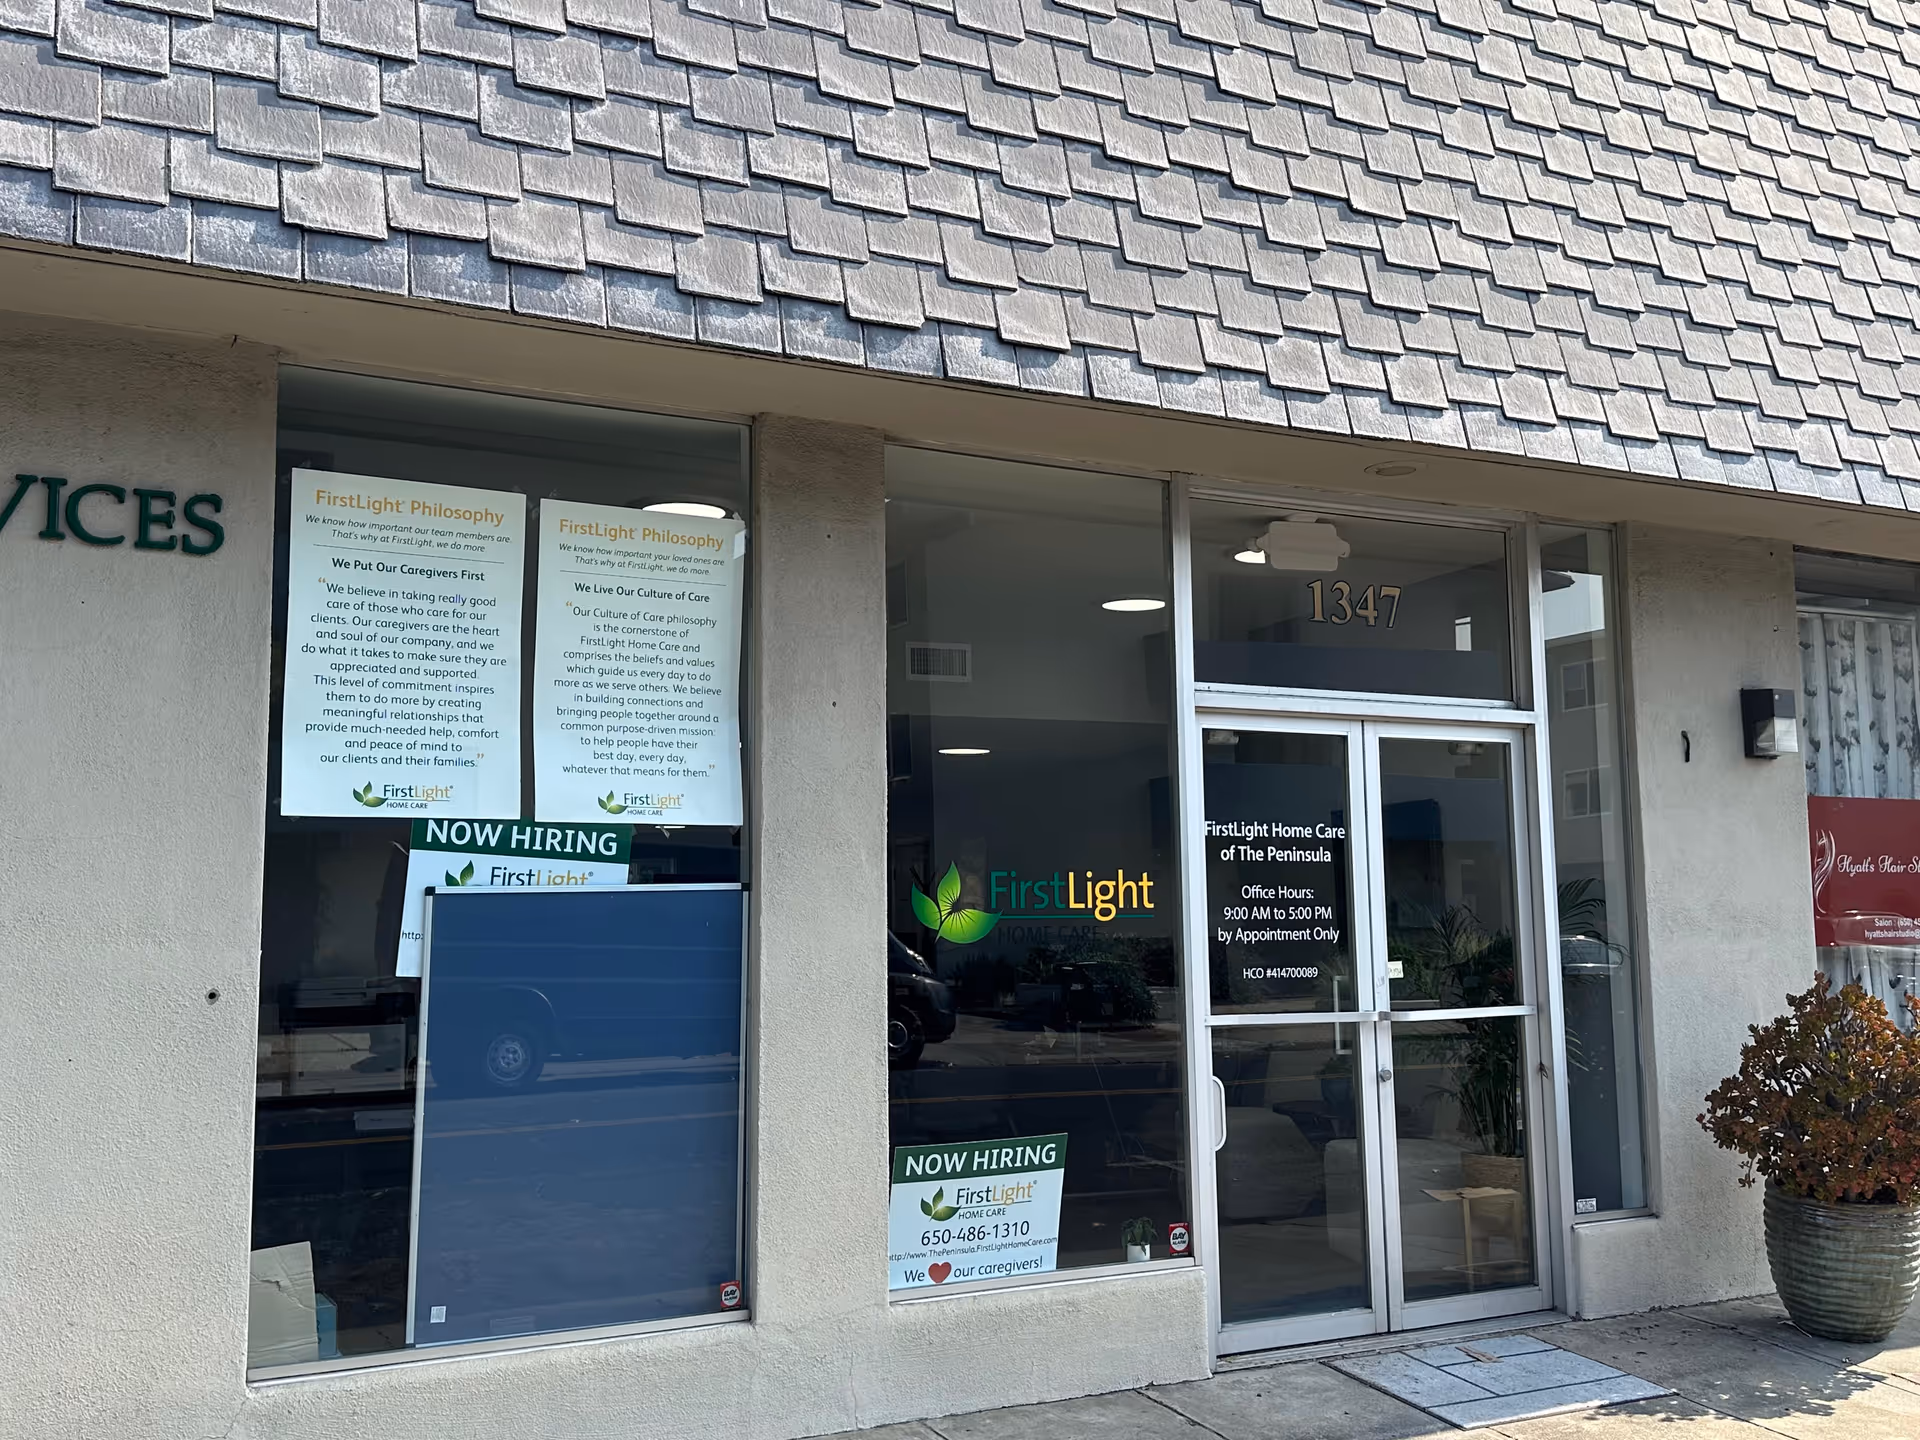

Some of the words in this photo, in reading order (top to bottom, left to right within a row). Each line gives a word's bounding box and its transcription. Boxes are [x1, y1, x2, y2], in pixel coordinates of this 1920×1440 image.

[411, 500, 504, 526] Philosophy
[642, 528, 724, 551] Philosophy
[332, 558, 351, 569] We
[354, 560, 373, 571] Put
[376, 562, 398, 573] Our
[400, 564, 458, 579] Caregivers
[461, 570, 485, 581] First
[574, 582, 591, 593] We
[594, 584, 614, 594] Live
[616, 585, 635, 596] Our
[637, 588, 673, 600] Culture
[675, 591, 686, 600] of
[688, 592, 710, 602] Care
[326, 601, 350, 610] care
[353, 601, 365, 611] of
[367, 602, 398, 614] those
[401, 605, 424, 616] who
[426, 609, 449, 618] care
[452, 608, 467, 619] for
[469, 612, 487, 620] our
[1307, 579, 1401, 628] 1347
[352, 616, 372, 627] Our
[375, 620, 429, 631] caregivers
[432, 624, 449, 632] are
[452, 624, 470, 634] the
[472, 625, 500, 636] heart
[316, 629, 338, 640] and
[340, 632, 363, 641] soul
[366, 632, 377, 642] of
[380, 636, 399, 644] our
[456, 640, 477, 649] and
[301, 642, 316, 654] do
[319, 644, 347, 656] what
[350, 647, 358, 657] it
[361, 648, 390, 658] takes
[392, 650, 404, 659] to
[407, 651, 437, 661] make
[439, 655, 462, 663] sure
[464, 654, 488, 666] they
[563, 651, 612, 661] comprises
[614, 652, 632, 662] the
[632, 653, 663, 664] beliefs
[666, 657, 684, 666] and
[686, 658, 715, 668] values
[330, 663, 396, 674] appreciated
[399, 666, 421, 675] and
[566, 664, 595, 674] which
[598, 666, 625, 677] guide
[640, 670, 665, 681] every
[668, 670, 685, 682] day
[687, 672, 697, 680] to
[699, 672, 711, 682] do
[315, 674, 336, 686] This
[340, 676, 364, 687] level
[367, 678, 379, 688] of
[382, 681, 452, 692] commitment
[455, 684, 494, 695] inspires
[326, 691, 356, 702] them
[359, 693, 371, 703] to
[373, 693, 388, 704] do
[391, 697, 420, 706] more
[422, 696, 436, 708] by
[438, 699, 482, 711] creating
[322, 706, 387, 720] meaningful
[390, 710, 459, 724] relationships
[462, 713, 484, 723] that
[556, 705, 598, 719] bringing
[600, 709, 633, 720] people
[635, 711, 676, 722] together
[678, 714, 711, 722] around
[305, 722, 348, 733] provide
[351, 724, 426, 735] much-needed
[458, 728, 499, 738] comfort
[560, 723, 604, 731] common
[606, 725, 676, 735] purpose-driven
[344, 738, 367, 748] and
[370, 741, 403, 751] peace
[406, 740, 417, 750] of
[420, 742, 448, 751] mind
[451, 743, 462, 752] to
[426, 820, 504, 847] NOW
[510, 826, 618, 856] HIRING
[1204, 821, 1268, 841] FirstLight
[1272, 823, 1312, 838] Home
[1316, 824, 1345, 839] Care
[1220, 845, 1236, 861] of
[1238, 846, 1264, 861] The
[1268, 846, 1331, 862] Peninsula
[1878, 855, 1906, 873] Hair
[990, 869, 1154, 921] FirstLight
[1242, 885, 1275, 899] Office
[1278, 886, 1314, 899] Hours:
[1224, 907, 1248, 920] 9:00
[1251, 907, 1271, 920] AM
[1274, 908, 1285, 920] to
[1289, 906, 1312, 920] 5:00
[1315, 906, 1332, 919] PM
[1218, 927, 1232, 944] by
[1235, 927, 1311, 944] Appointment
[1313, 927, 1339, 944] Only
[1243, 968, 1264, 979] HCO
[906, 1152, 968, 1176] NOW
[973, 1144, 1056, 1170] HIRING
[958, 1209, 984, 1220] HOME
[986, 1208, 1006, 1217] CARE
[921, 1221, 1030, 1246] 650-486-1310
[905, 1270, 925, 1283] We
[954, 1266, 975, 1278] our
[978, 1256, 1043, 1275] caregivers!
